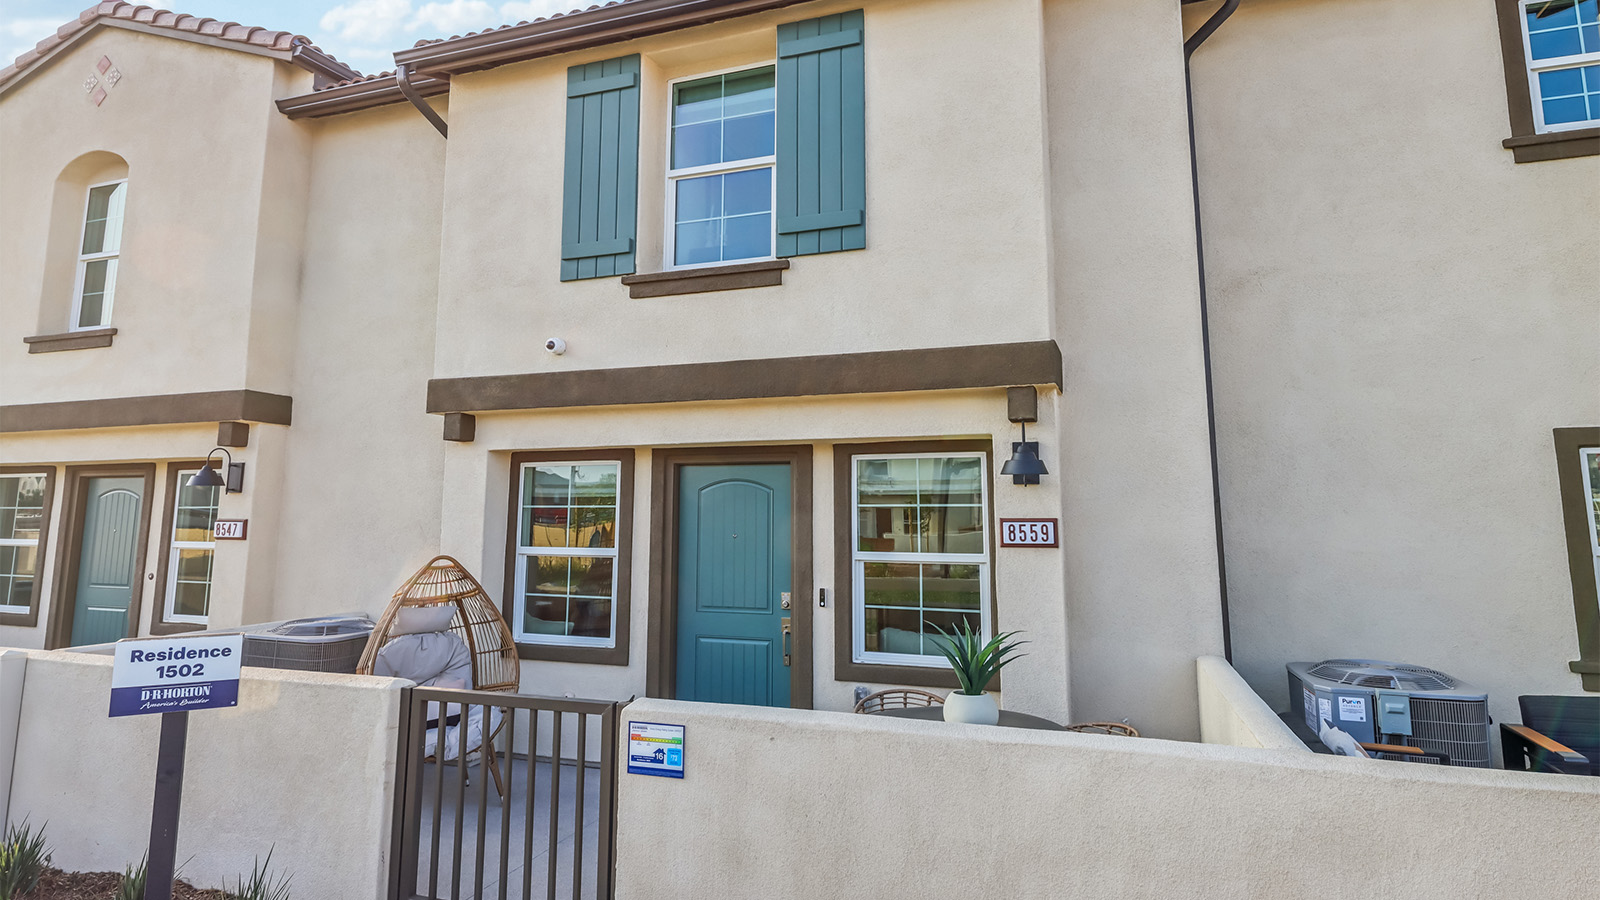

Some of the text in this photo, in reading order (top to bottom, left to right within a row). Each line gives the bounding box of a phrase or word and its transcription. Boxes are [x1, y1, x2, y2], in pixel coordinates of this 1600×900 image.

[215, 523, 238, 536] 8547
[1008, 523, 1050, 542] 8559
[130, 646, 232, 663] Residence
[156, 663, 205, 679] 1502
[139, 698, 210, 710] America's Builder
[655, 752, 664, 761] 16
